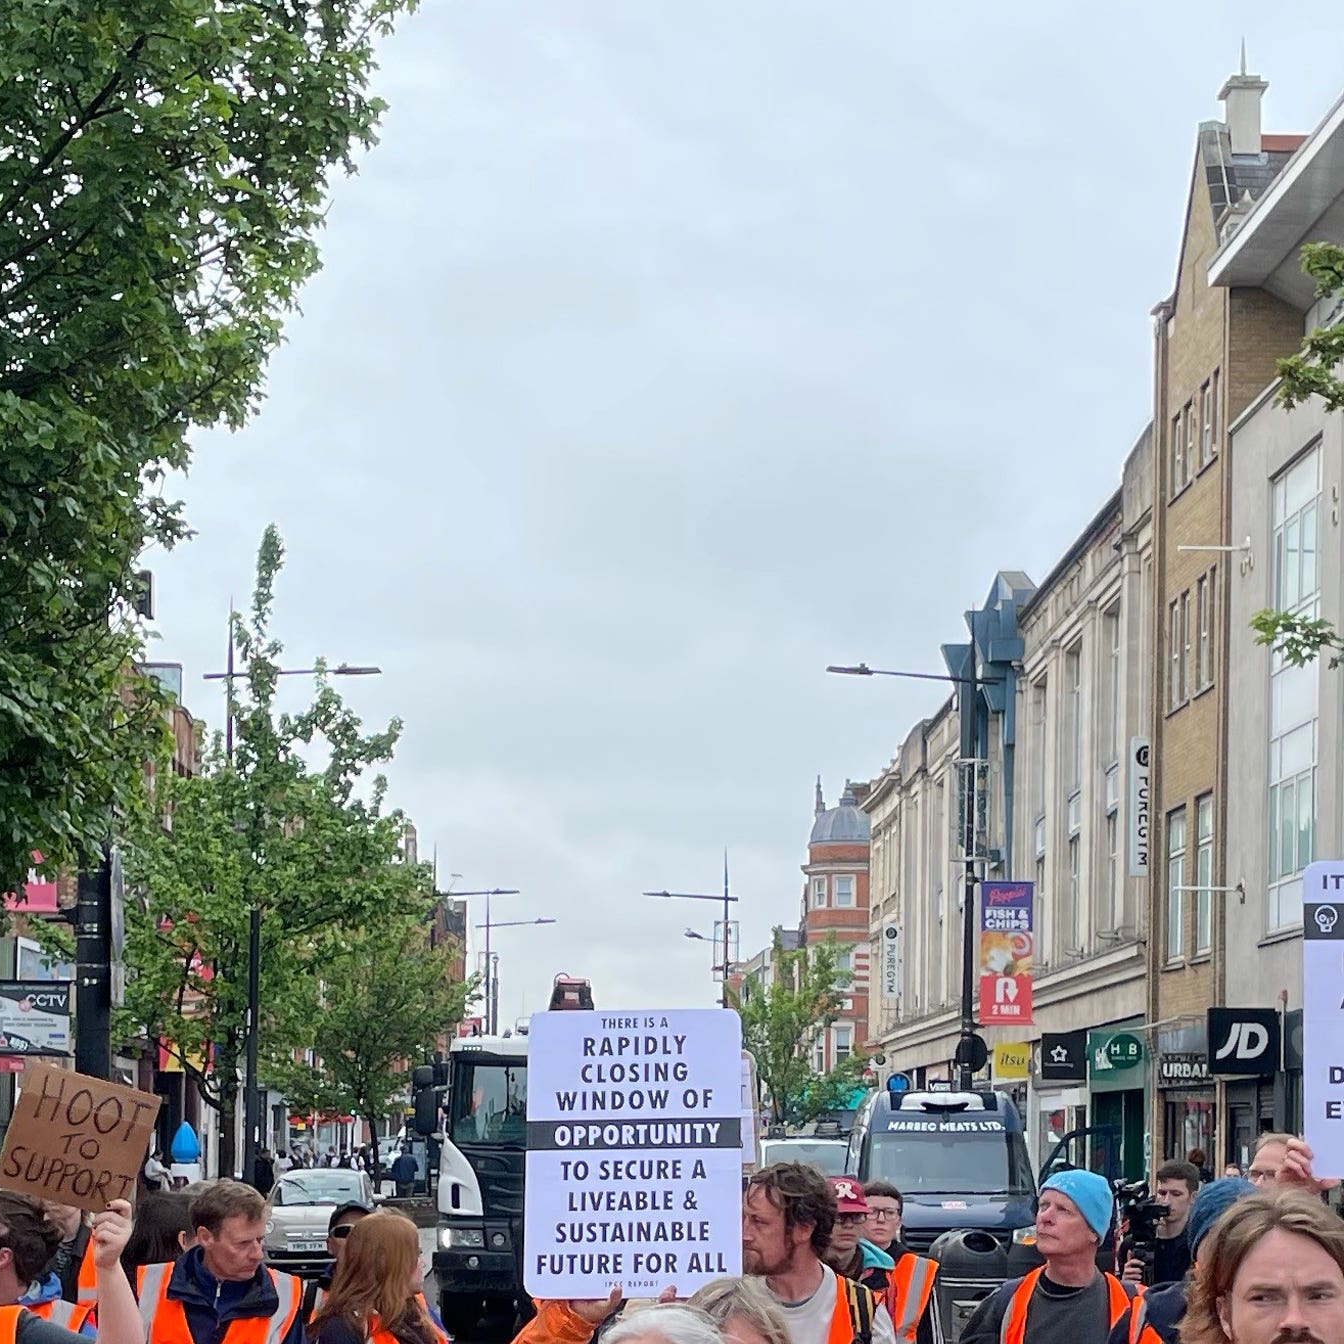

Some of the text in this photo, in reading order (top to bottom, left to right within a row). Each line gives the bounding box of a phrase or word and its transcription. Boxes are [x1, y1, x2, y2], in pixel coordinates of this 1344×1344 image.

[985, 909, 1029, 920] FISH &
[985, 919, 1029, 930] CHIPS
[886, 943, 896, 993] PUREGYM
[25, 993, 67, 1008] CCTV
[991, 1005, 1021, 1016] 2 MIN
[601, 1016, 669, 1030] THERE IS A
[583, 1035, 688, 1057] RAPIDLY
[1216, 1022, 1270, 1060] JD
[1000, 1052, 1026, 1066] itsu
[581, 1062, 689, 1084] CLOSING
[33, 1074, 152, 1142] HOOT
[556, 1089, 714, 1112] WINDOW OF
[553, 1122, 721, 1147] OPPORTUNITY
[940, 1121, 978, 1132] MEATS
[980, 1121, 1007, 1131] LTD.
[60, 1133, 100, 1160] TO
[3, 1146, 134, 1204] SUPPORT
[560, 1159, 707, 1181] TO SECURE A
[568, 1189, 699, 1212] LIVEABLE &
[834, 1181, 857, 1200] R
[555, 1221, 710, 1244] SUSTAINABLE
[536, 1252, 728, 1275] FUTURE FOR ALL
